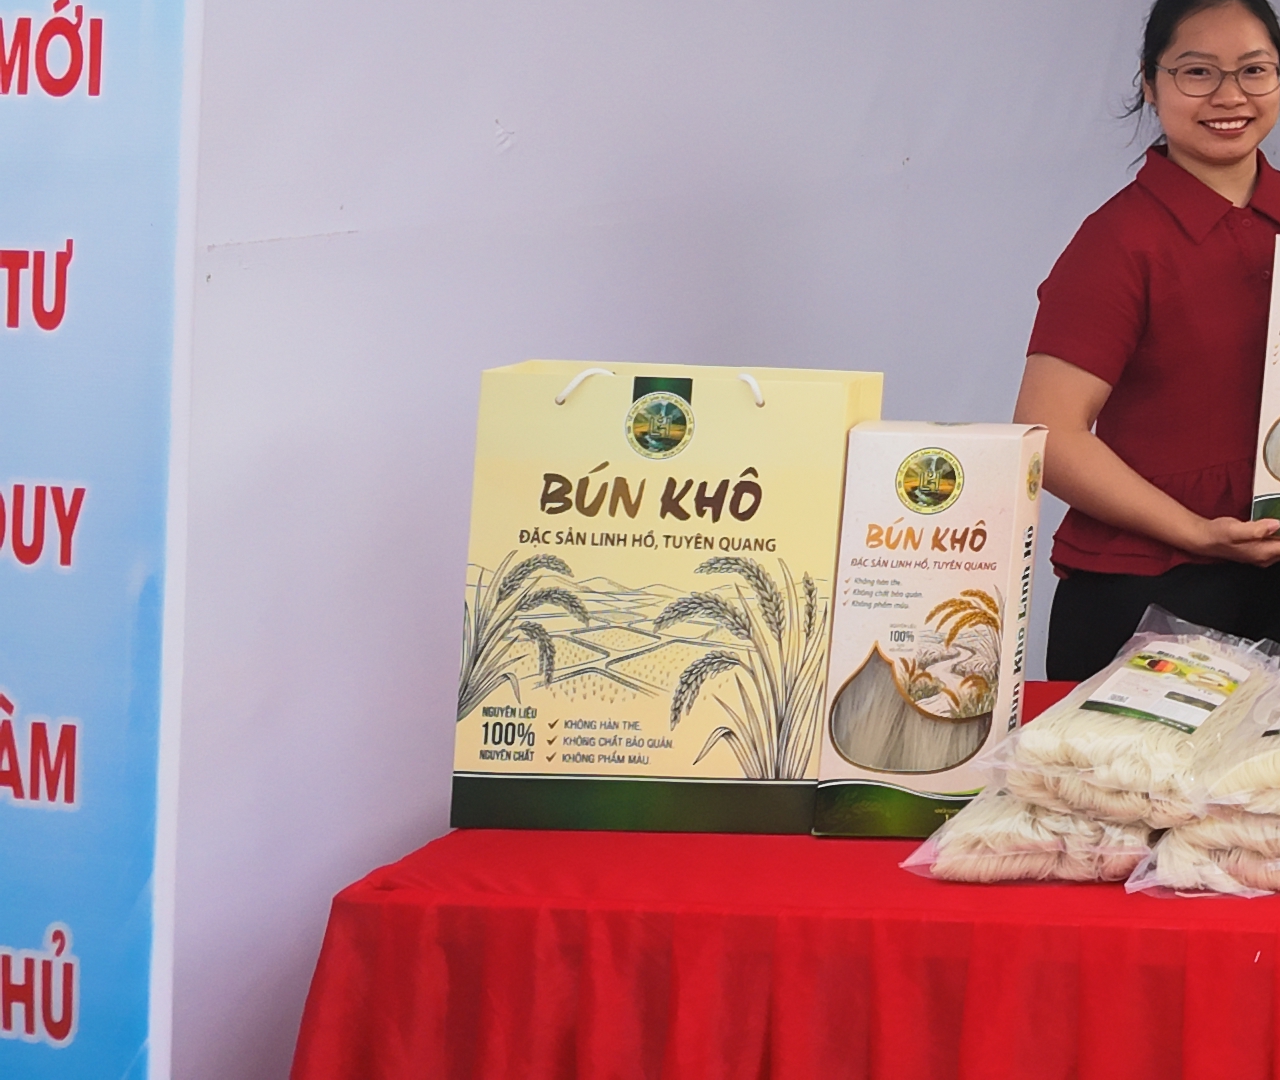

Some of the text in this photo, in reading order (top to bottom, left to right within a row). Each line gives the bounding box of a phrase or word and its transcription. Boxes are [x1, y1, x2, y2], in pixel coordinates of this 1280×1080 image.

[540, 461, 762, 523] BÚN KHÔ
[0, 485, 86, 567] UY
[519, 527, 551, 548] ĐẶC
[556, 527, 587, 545] SẢN
[591, 532, 627, 547] LINH
[662, 533, 715, 550] TUYÊN
[718, 536, 777, 552] QUANG
[865, 517, 988, 554] BÚN KHÔ
[964, 561, 997, 571] QUANG
[889, 630, 914, 642] 100%
[481, 721, 535, 747] 100%
[0, 929, 74, 1040] HỦ
